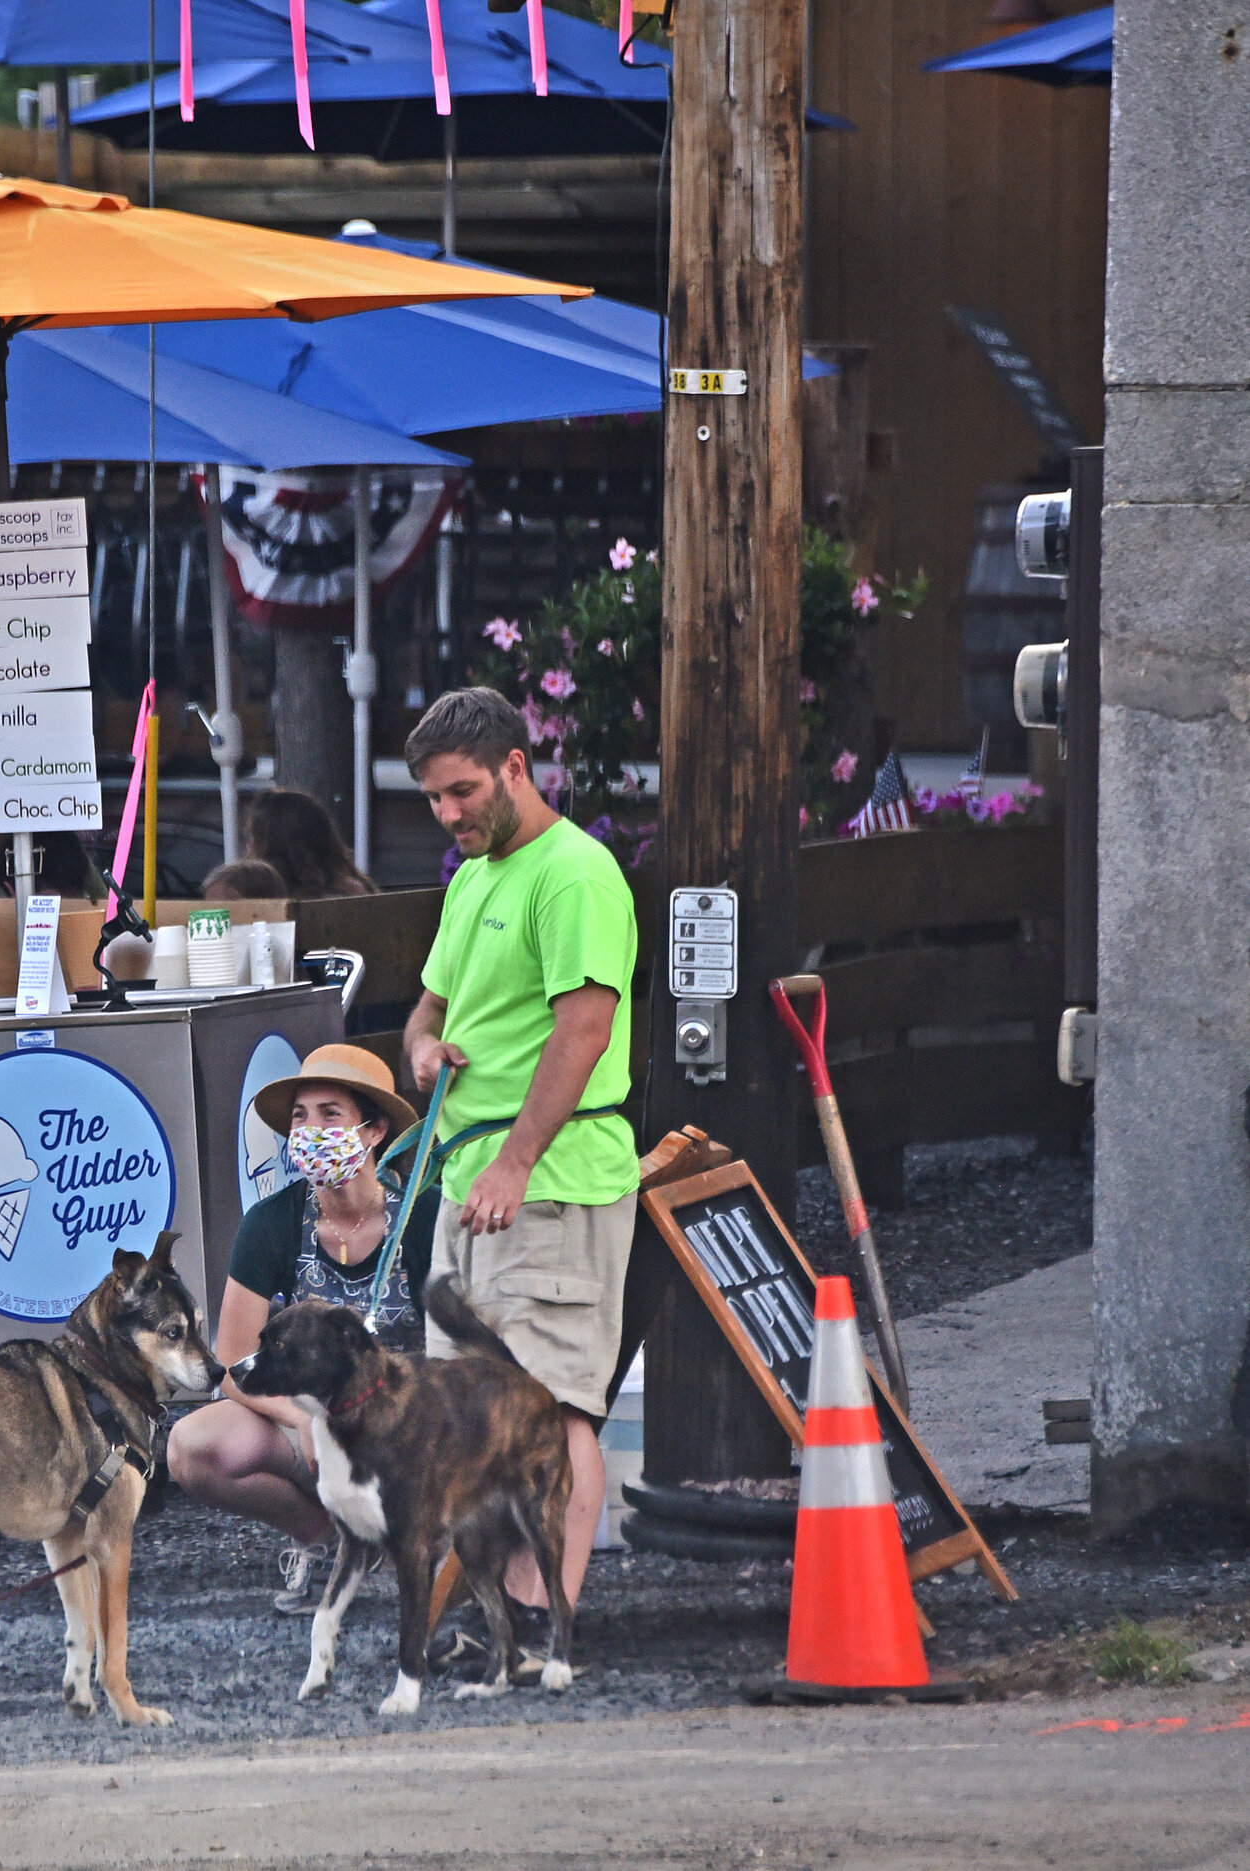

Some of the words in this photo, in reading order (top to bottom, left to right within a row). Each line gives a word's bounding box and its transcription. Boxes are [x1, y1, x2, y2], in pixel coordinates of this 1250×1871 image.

[0, 511, 42, 528] scoop
[56, 511, 74, 522] tax
[0, 531, 49, 547] scoops
[56, 524, 76, 535] inc.
[7, 617, 51, 642] Chip
[0, 755, 92, 778] Cardamom
[4, 797, 53, 819] Choc.
[57, 796, 99, 820] Chip
[38, 1108, 109, 1151] The
[46, 1148, 161, 1194] Udder
[52, 1195, 146, 1250] Guys
[684, 1206, 784, 1289] WE'RE
[726, 1275, 815, 1370] OPEN
